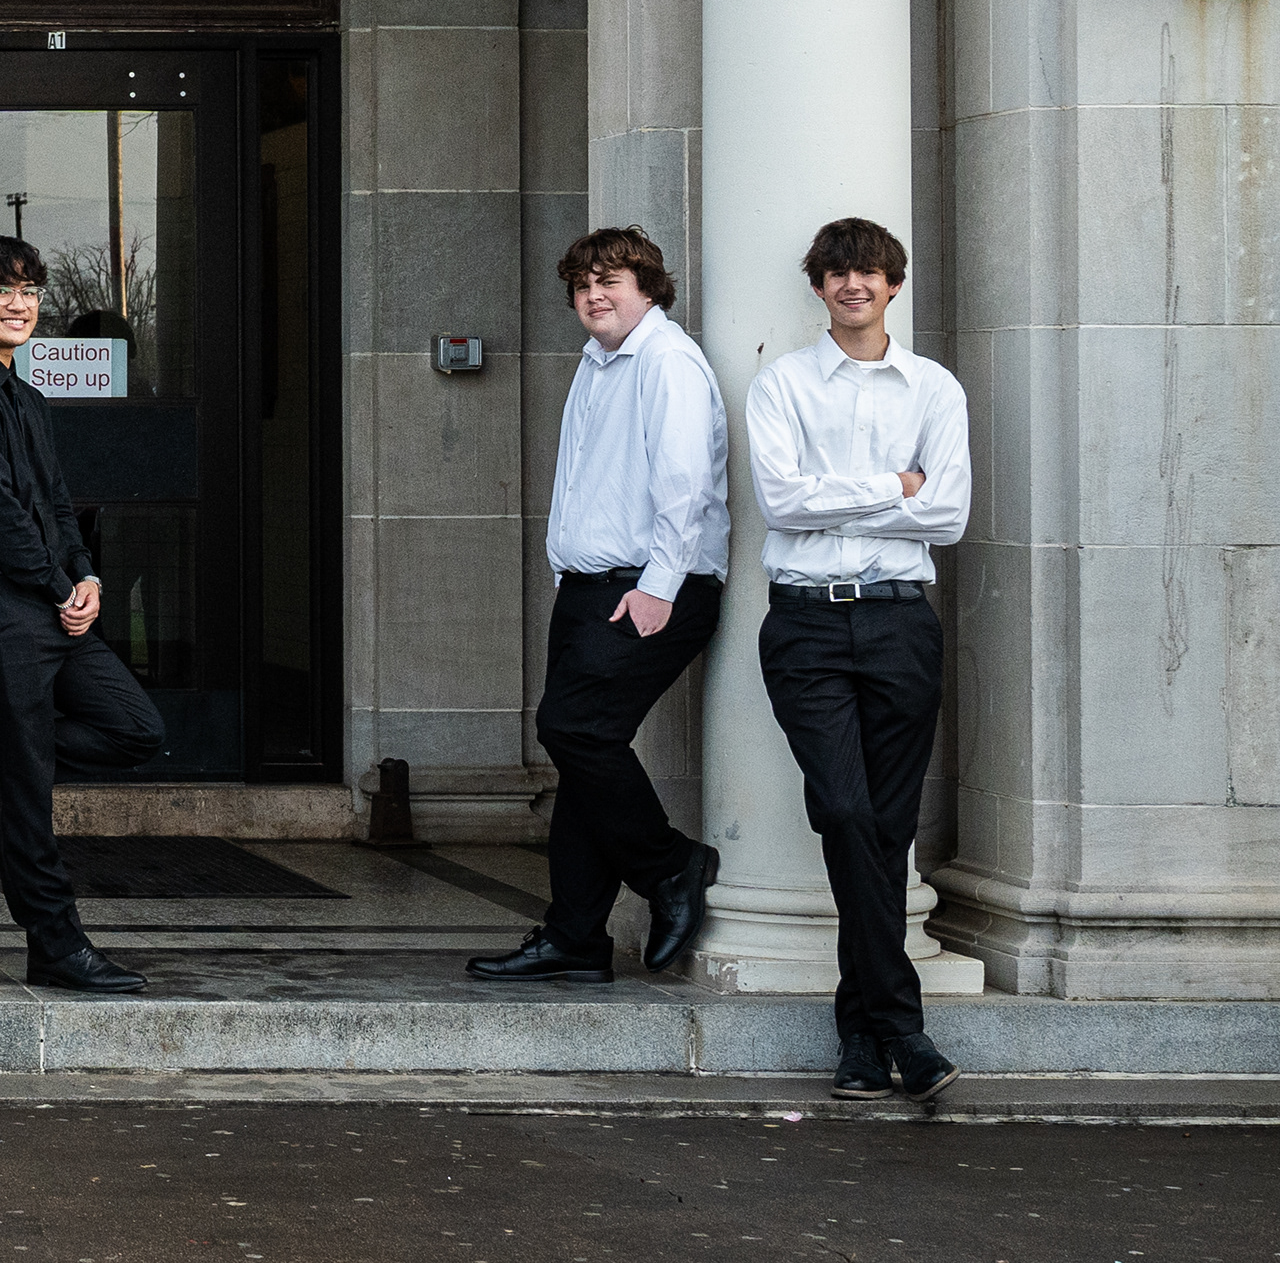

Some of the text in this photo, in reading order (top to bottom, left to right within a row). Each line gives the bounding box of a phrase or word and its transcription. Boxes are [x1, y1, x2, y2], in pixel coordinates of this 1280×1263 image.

[48, 32, 65, 49] A1
[31, 342, 111, 362] Caution
[31, 368, 111, 390] Step up
